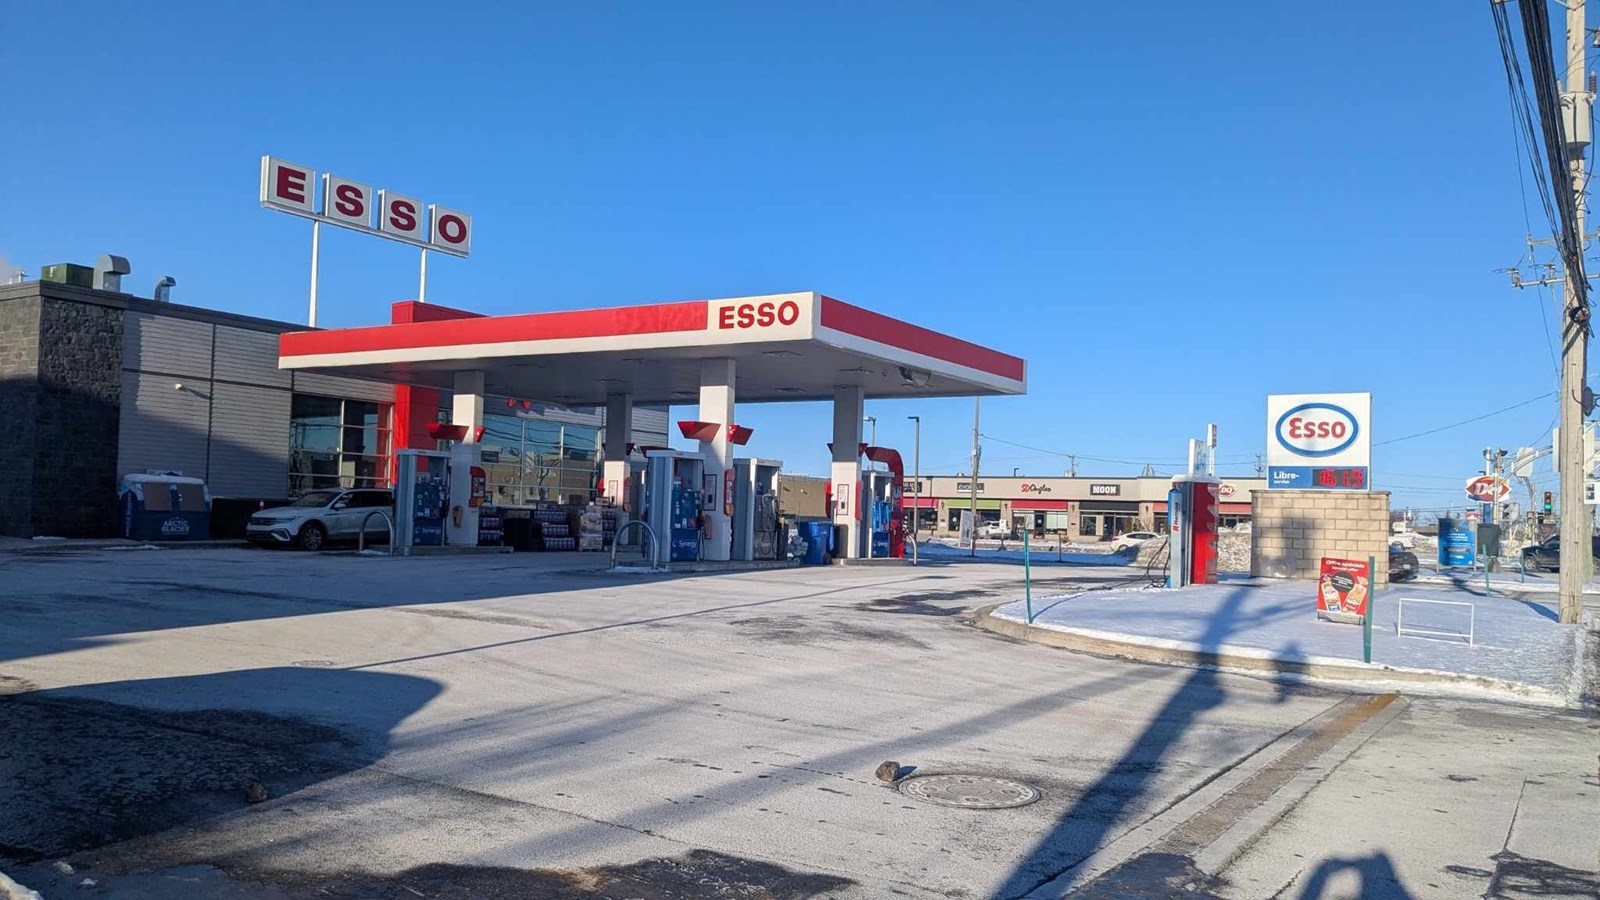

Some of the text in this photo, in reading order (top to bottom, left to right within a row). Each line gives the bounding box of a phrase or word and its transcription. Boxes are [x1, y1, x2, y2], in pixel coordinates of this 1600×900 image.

[719, 301, 799, 329] ESSO
[1289, 417, 1346, 439] Esso
[1273, 471, 1299, 479] Libre-
[1092, 485, 1117, 494] MOON
[1221, 486, 1234, 494] DQ
[422, 527, 442, 535] Synergy
[678, 540, 698, 549] Synergy
